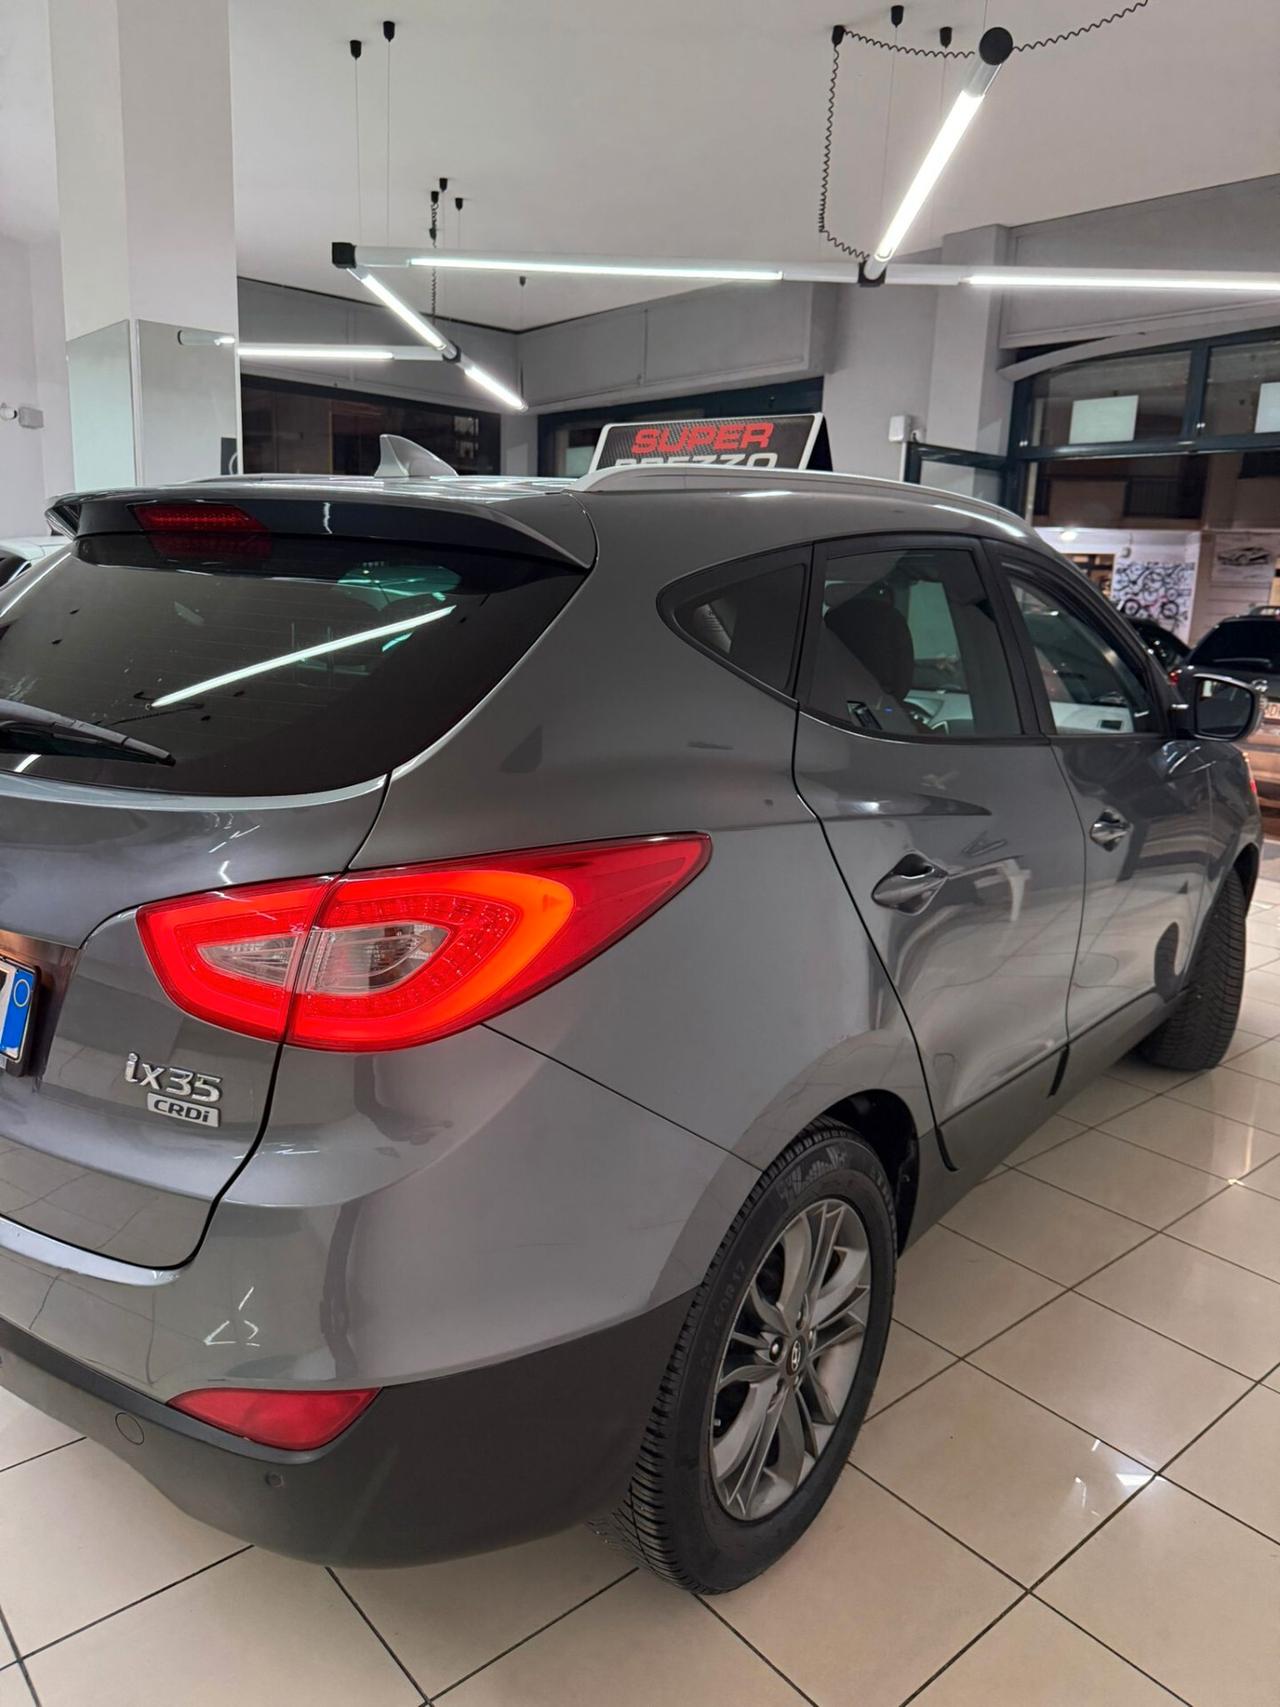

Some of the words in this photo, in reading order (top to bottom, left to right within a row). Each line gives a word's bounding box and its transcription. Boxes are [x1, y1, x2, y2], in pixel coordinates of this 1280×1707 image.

[631, 423, 775, 454] SUPER
[124, 1052, 222, 1102] ix35
[153, 1099, 210, 1122] CRDi
